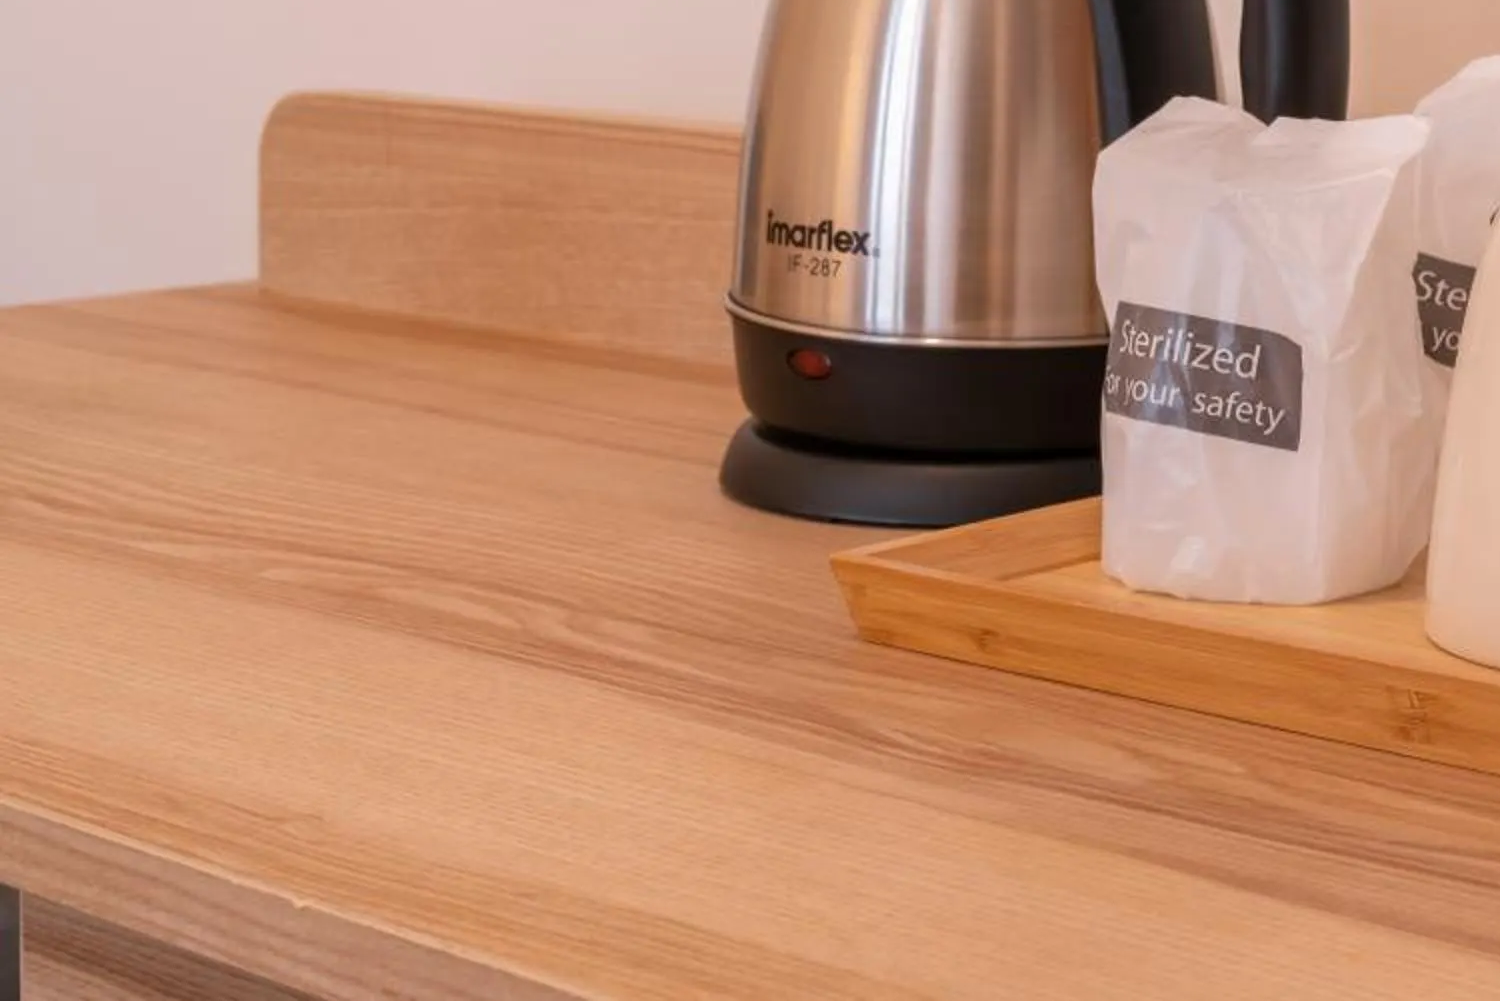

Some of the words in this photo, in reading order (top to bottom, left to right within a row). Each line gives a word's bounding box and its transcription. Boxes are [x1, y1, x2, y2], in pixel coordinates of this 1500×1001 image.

[766, 209, 871, 257] imarflex
[788, 255, 842, 278] IF-287
[1119, 319, 1261, 381] Sterilized
[1124, 379, 1181, 407] your
[1192, 391, 1286, 436] safety
